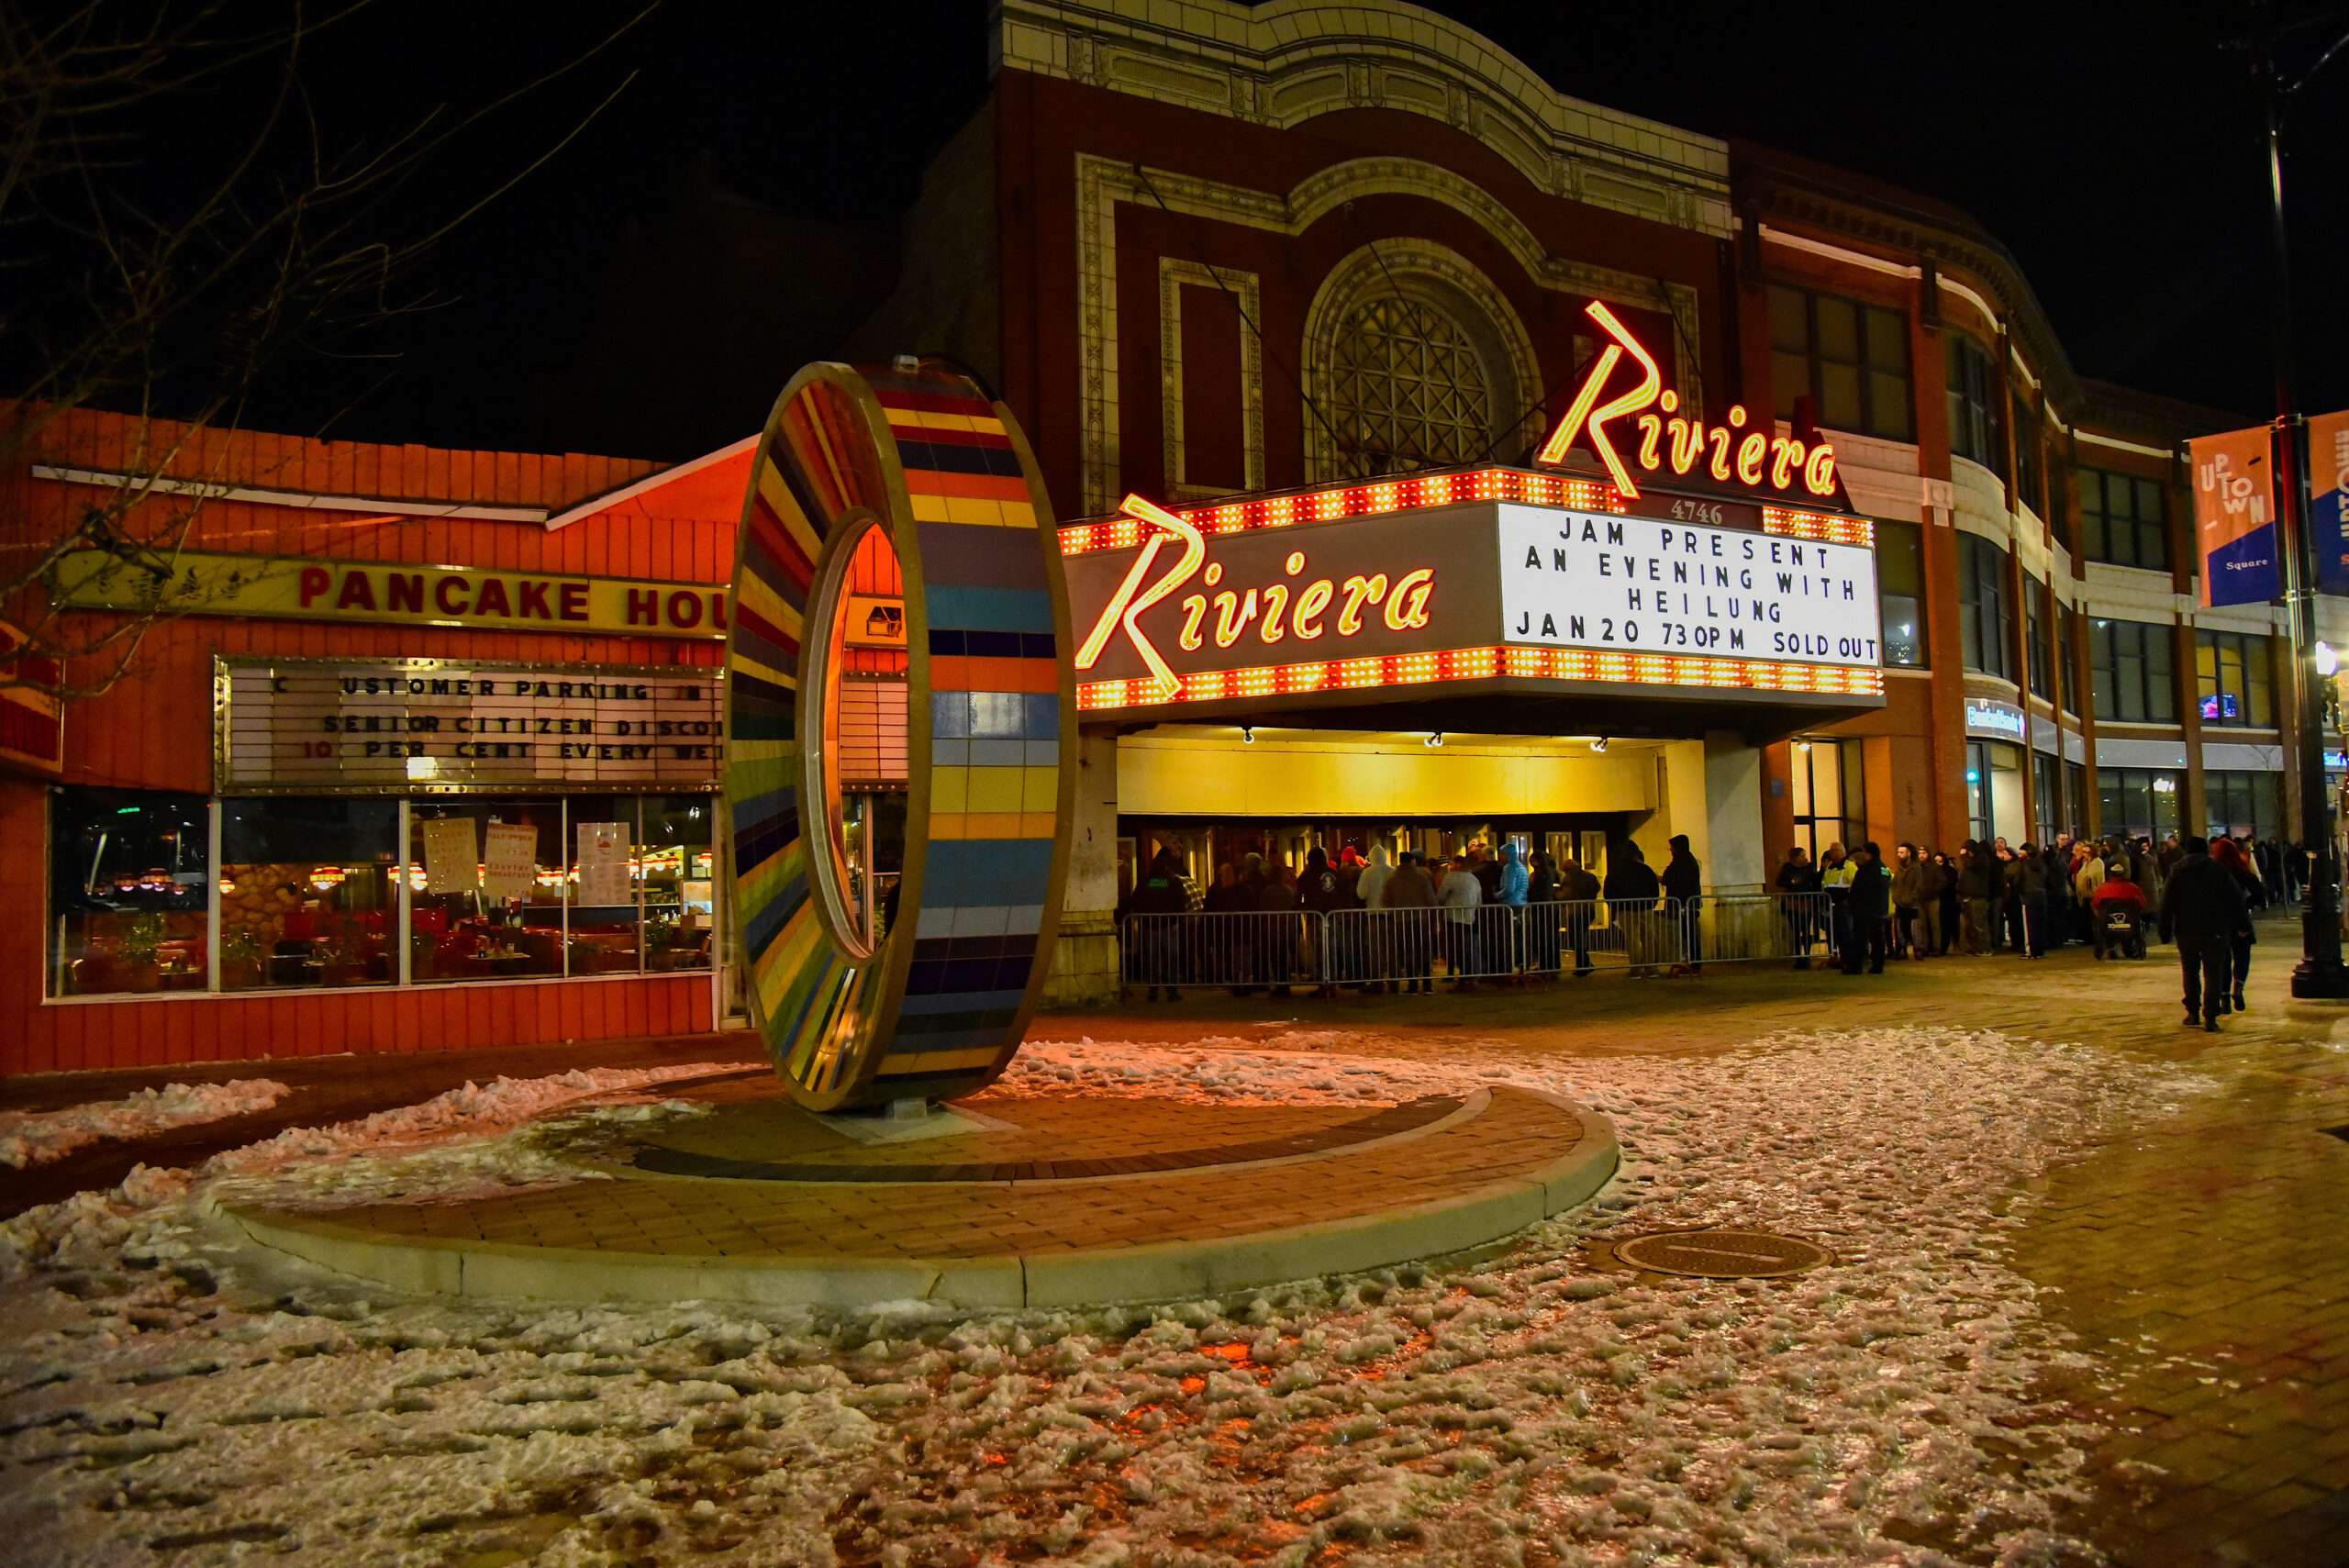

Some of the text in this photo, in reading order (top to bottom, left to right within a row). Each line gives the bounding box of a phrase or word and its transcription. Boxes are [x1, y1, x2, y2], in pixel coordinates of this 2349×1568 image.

[1539, 300, 1836, 499] Riviera
[1671, 500, 1722, 525] 4746
[1560, 517, 1827, 569] JAM PRESENT
[1526, 546, 1853, 600] AN EVENING WITH
[2226, 558, 2268, 571] Square
[300, 568, 589, 621] PANCAKE
[1074, 494, 1434, 697] Riviera
[1629, 588, 1781, 623] HEILUNG
[1517, 612, 1584, 639] JAN
[1602, 618, 1638, 642] 20
[1775, 632, 1828, 655] SOLD
[1840, 638, 1875, 659] OUT
[517, 681, 647, 700] PARKING
[323, 716, 440, 732] SENIOR
[456, 717, 591, 734] CITIZEN
[304, 741, 722, 760] 10 PER CENT EVERY WE
